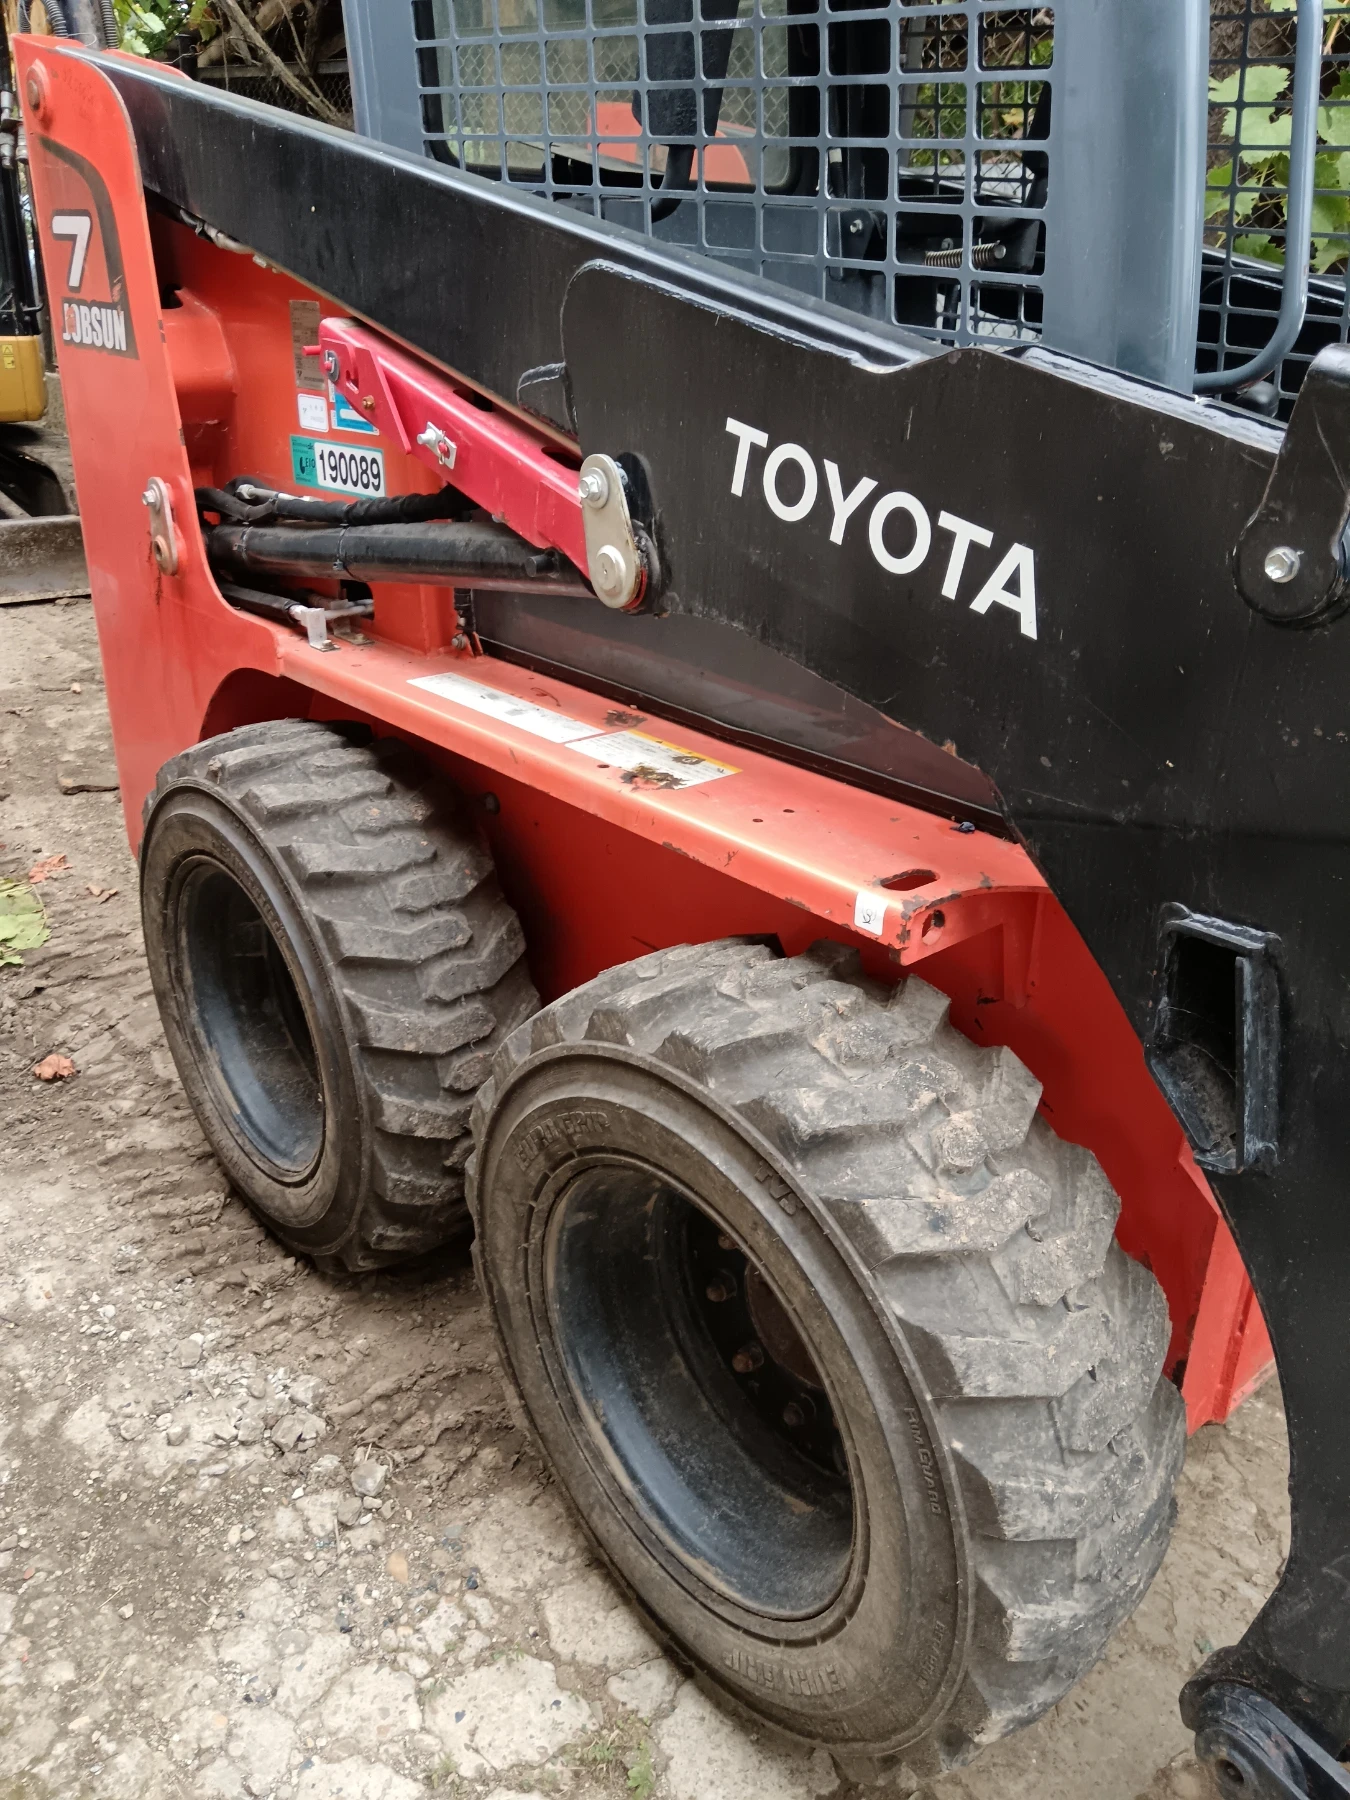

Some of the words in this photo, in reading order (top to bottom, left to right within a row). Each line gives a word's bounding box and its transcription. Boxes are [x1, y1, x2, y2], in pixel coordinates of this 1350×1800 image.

[52, 215, 91, 288] 7
[319, 449, 381, 492] 190089
[725, 416, 1038, 641] TOYOTA
